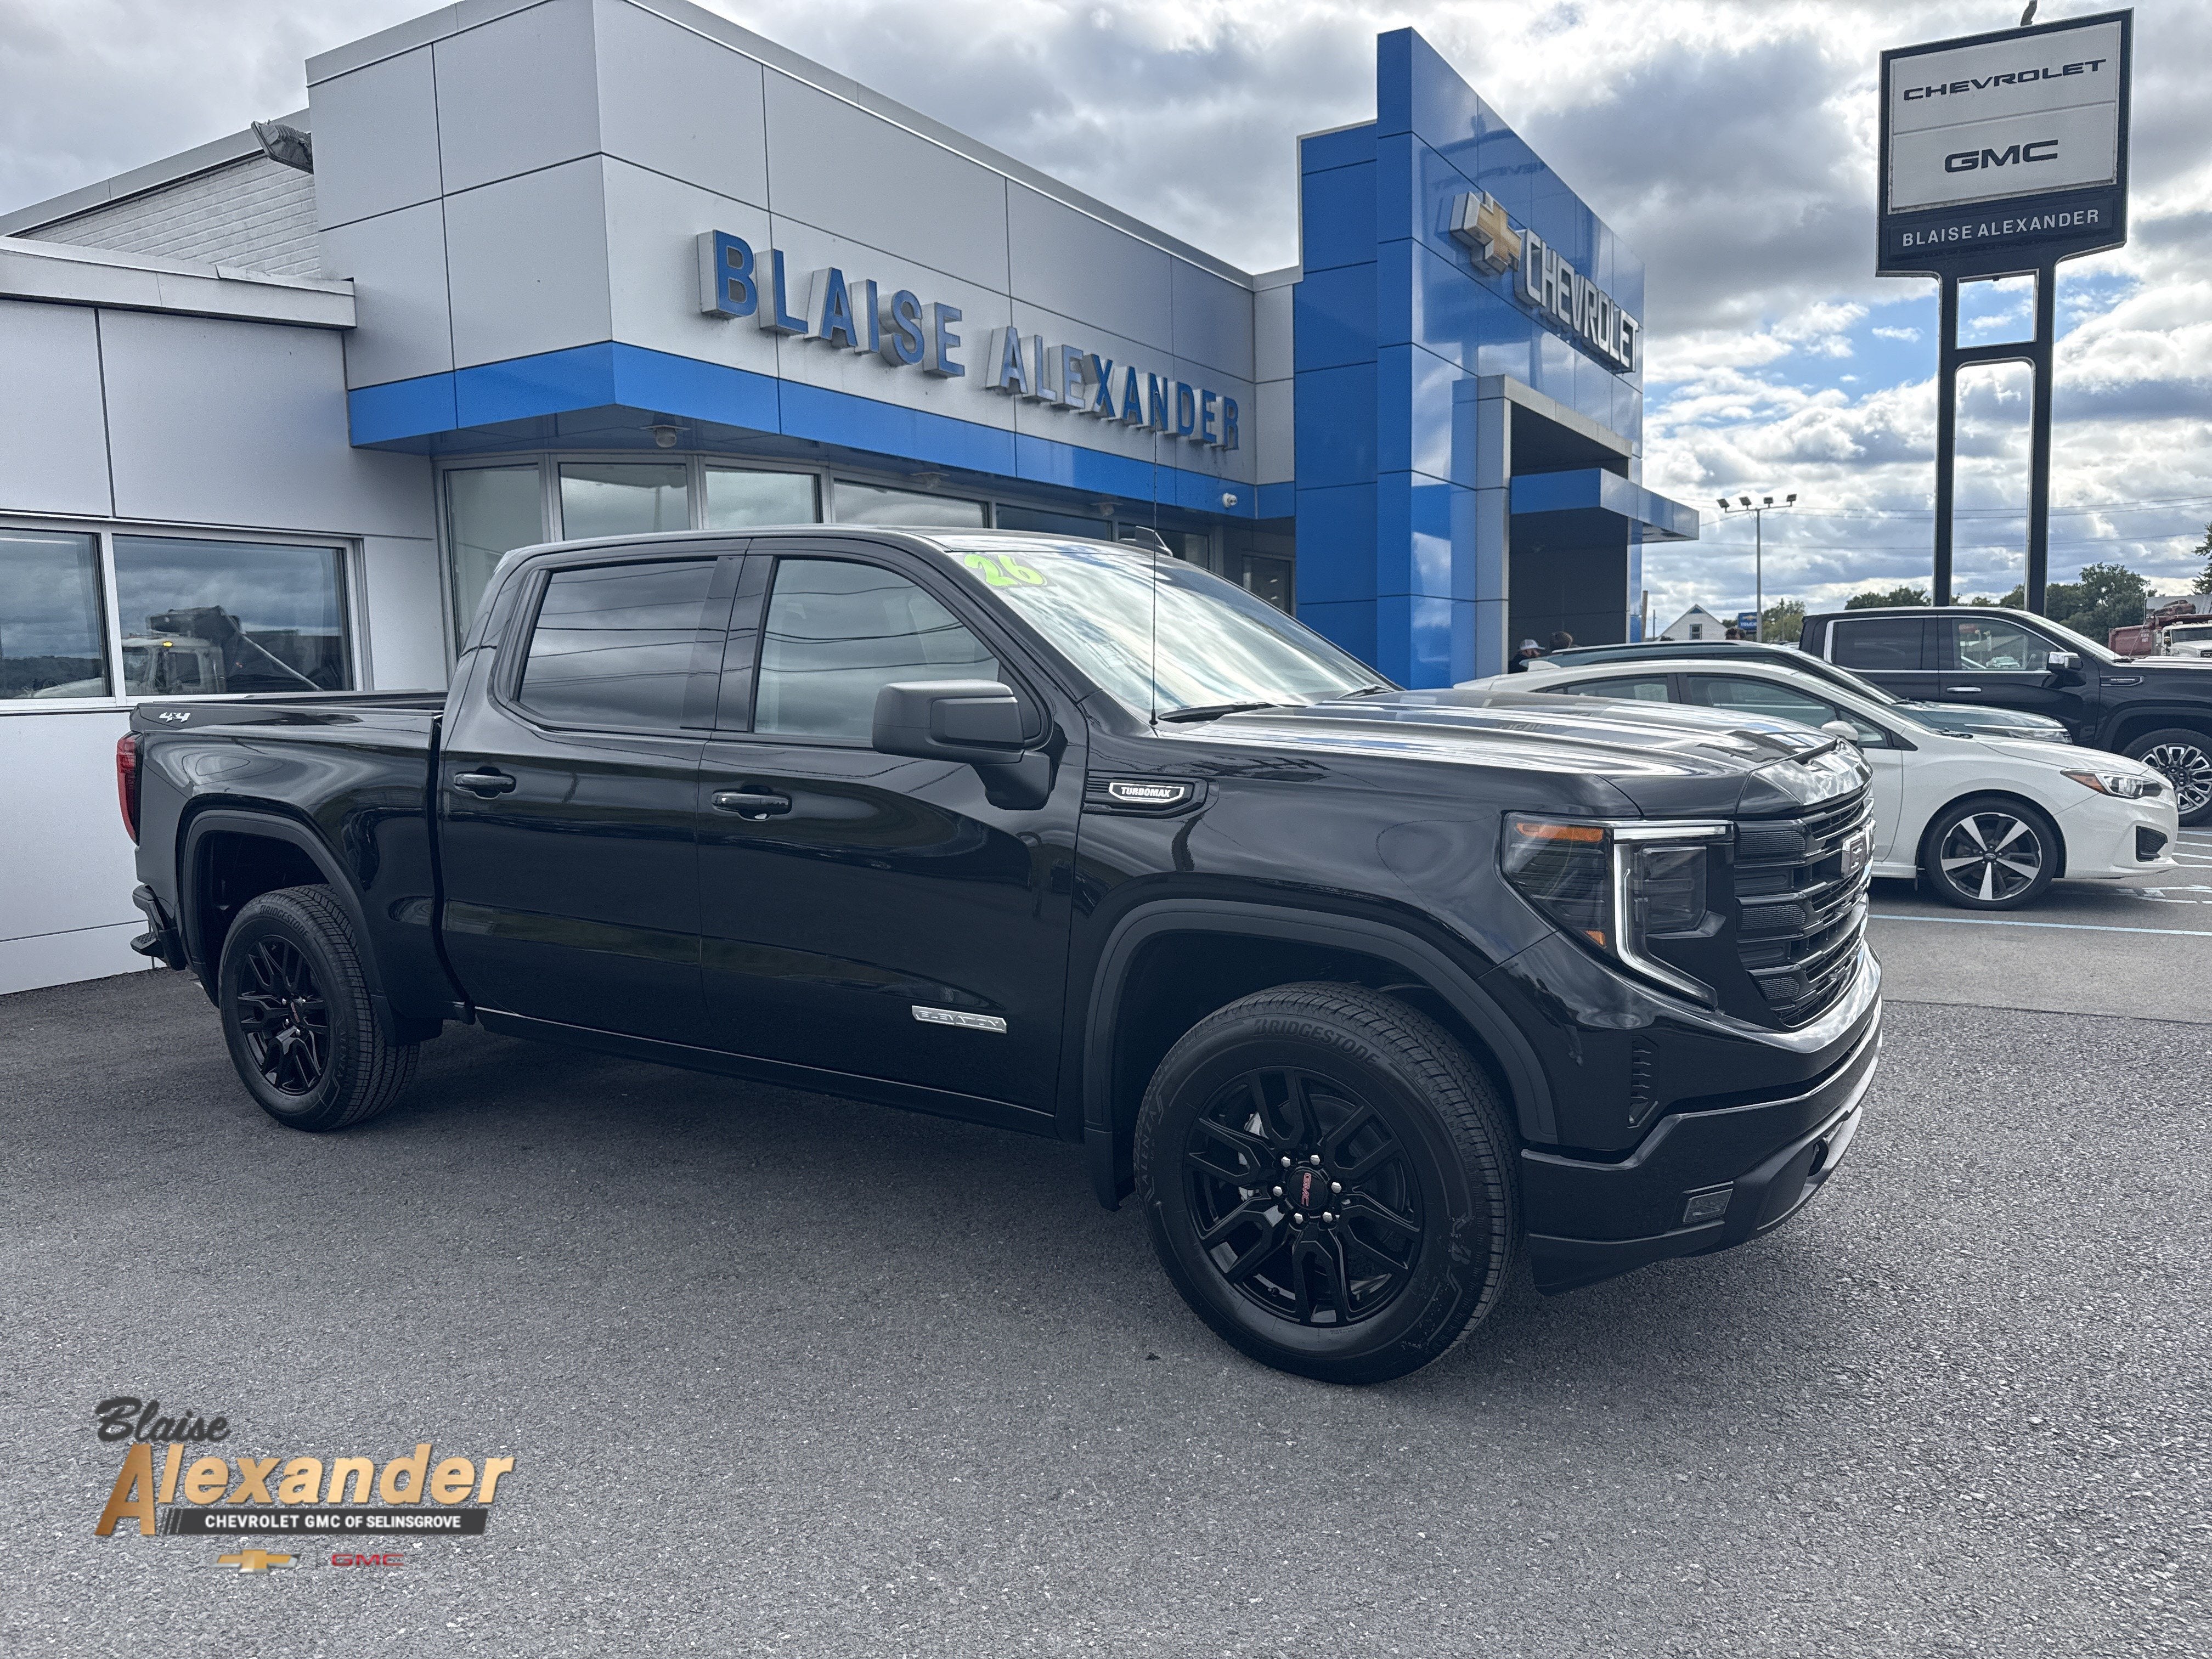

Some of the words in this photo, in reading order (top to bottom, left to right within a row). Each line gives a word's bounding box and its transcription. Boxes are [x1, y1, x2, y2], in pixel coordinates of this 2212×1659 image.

[1904, 59, 2106, 101] CHEVROLET
[1945, 139, 2058, 173] GMC
[1903, 225, 1972, 247] BLAISE
[1977, 209, 2099, 238] ALEXANDER
[1525, 228, 1639, 373] CHEVROLET
[713, 229, 965, 378] BLAISE
[1000, 326, 1239, 450] ALEXANDER
[964, 554, 1045, 586] 26
[1121, 787, 1171, 798] TURBOMAX
[259, 905, 310, 939] BRIDGESTONE
[917, 1011, 1001, 1028] ELEVATION
[1254, 1018, 1380, 1066] BRIDGESTONE
[1141, 1110, 1156, 1185] ALENZA
[1301, 1173, 1312, 1206] GMC
